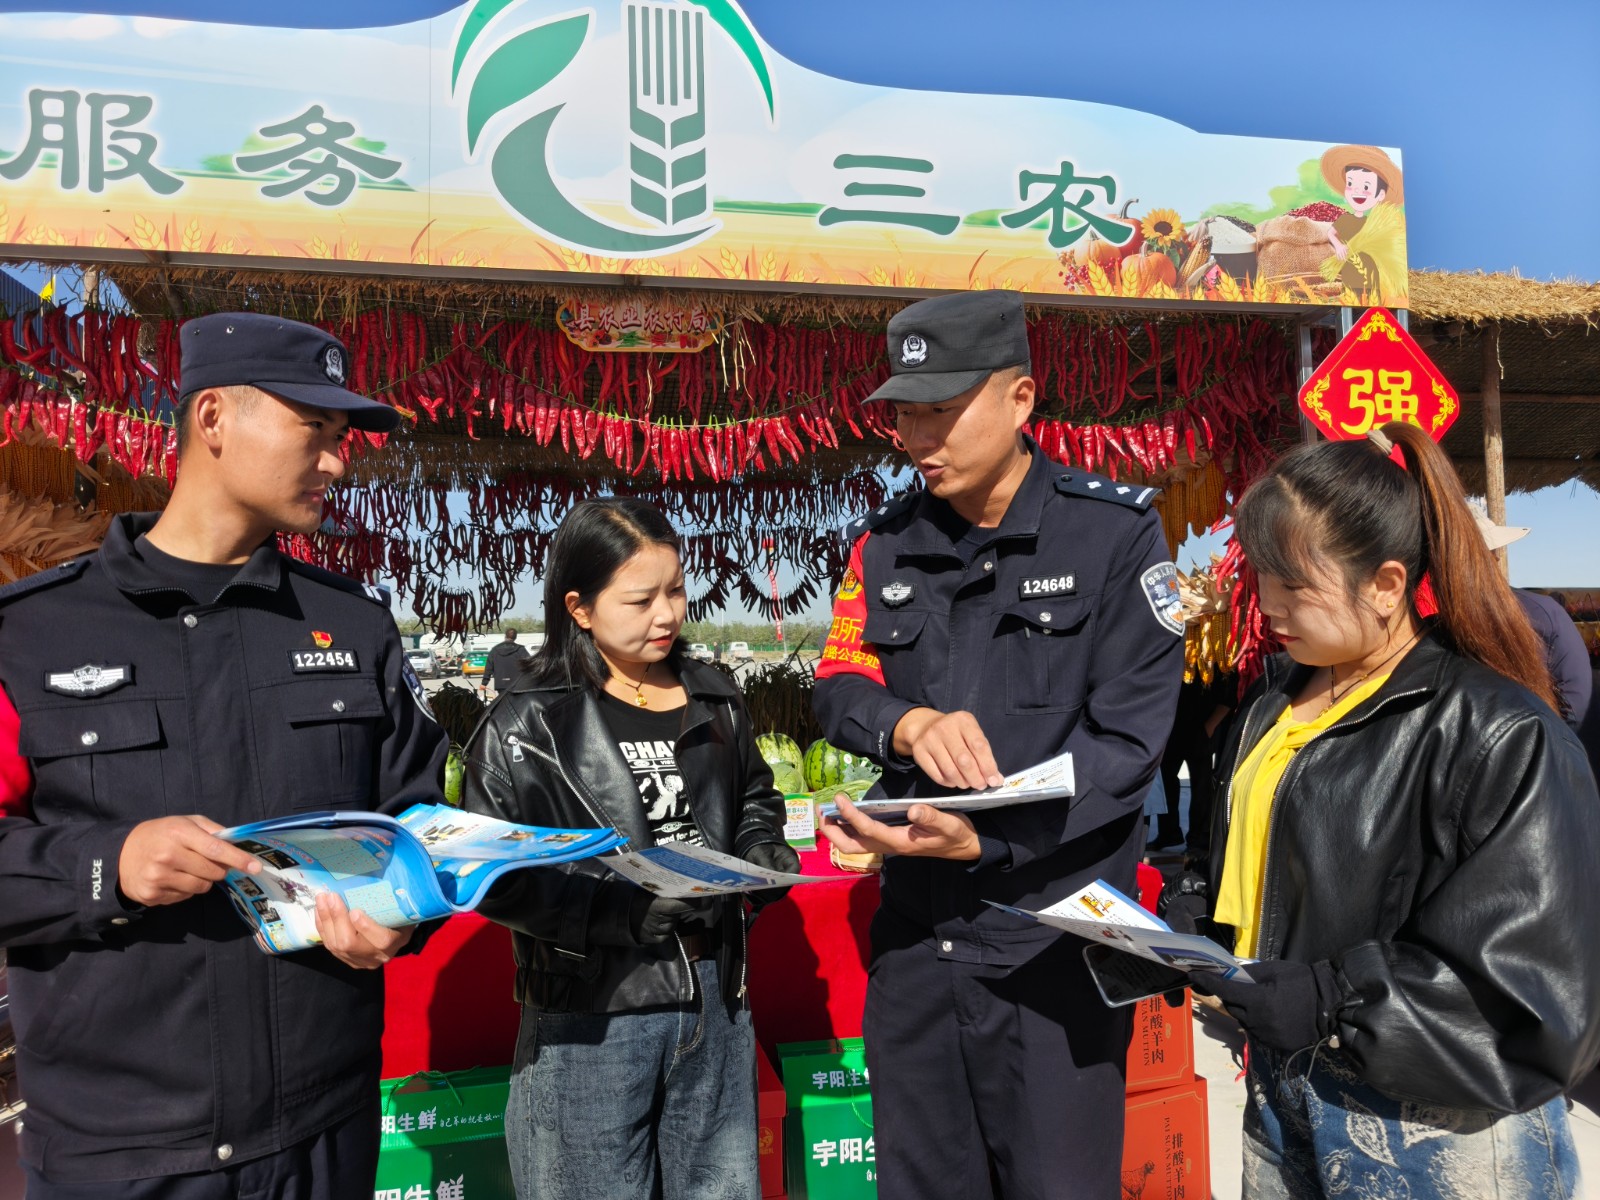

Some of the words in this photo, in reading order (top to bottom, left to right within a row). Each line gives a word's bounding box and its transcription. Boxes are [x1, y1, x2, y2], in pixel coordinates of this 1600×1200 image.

[1340, 368, 1424, 435] 强
[1023, 576, 1074, 594] 124648
[294, 652, 354, 667] 122454
[92, 859, 103, 900] POLICE
[1149, 997, 1164, 1064] 排酸羊肉
